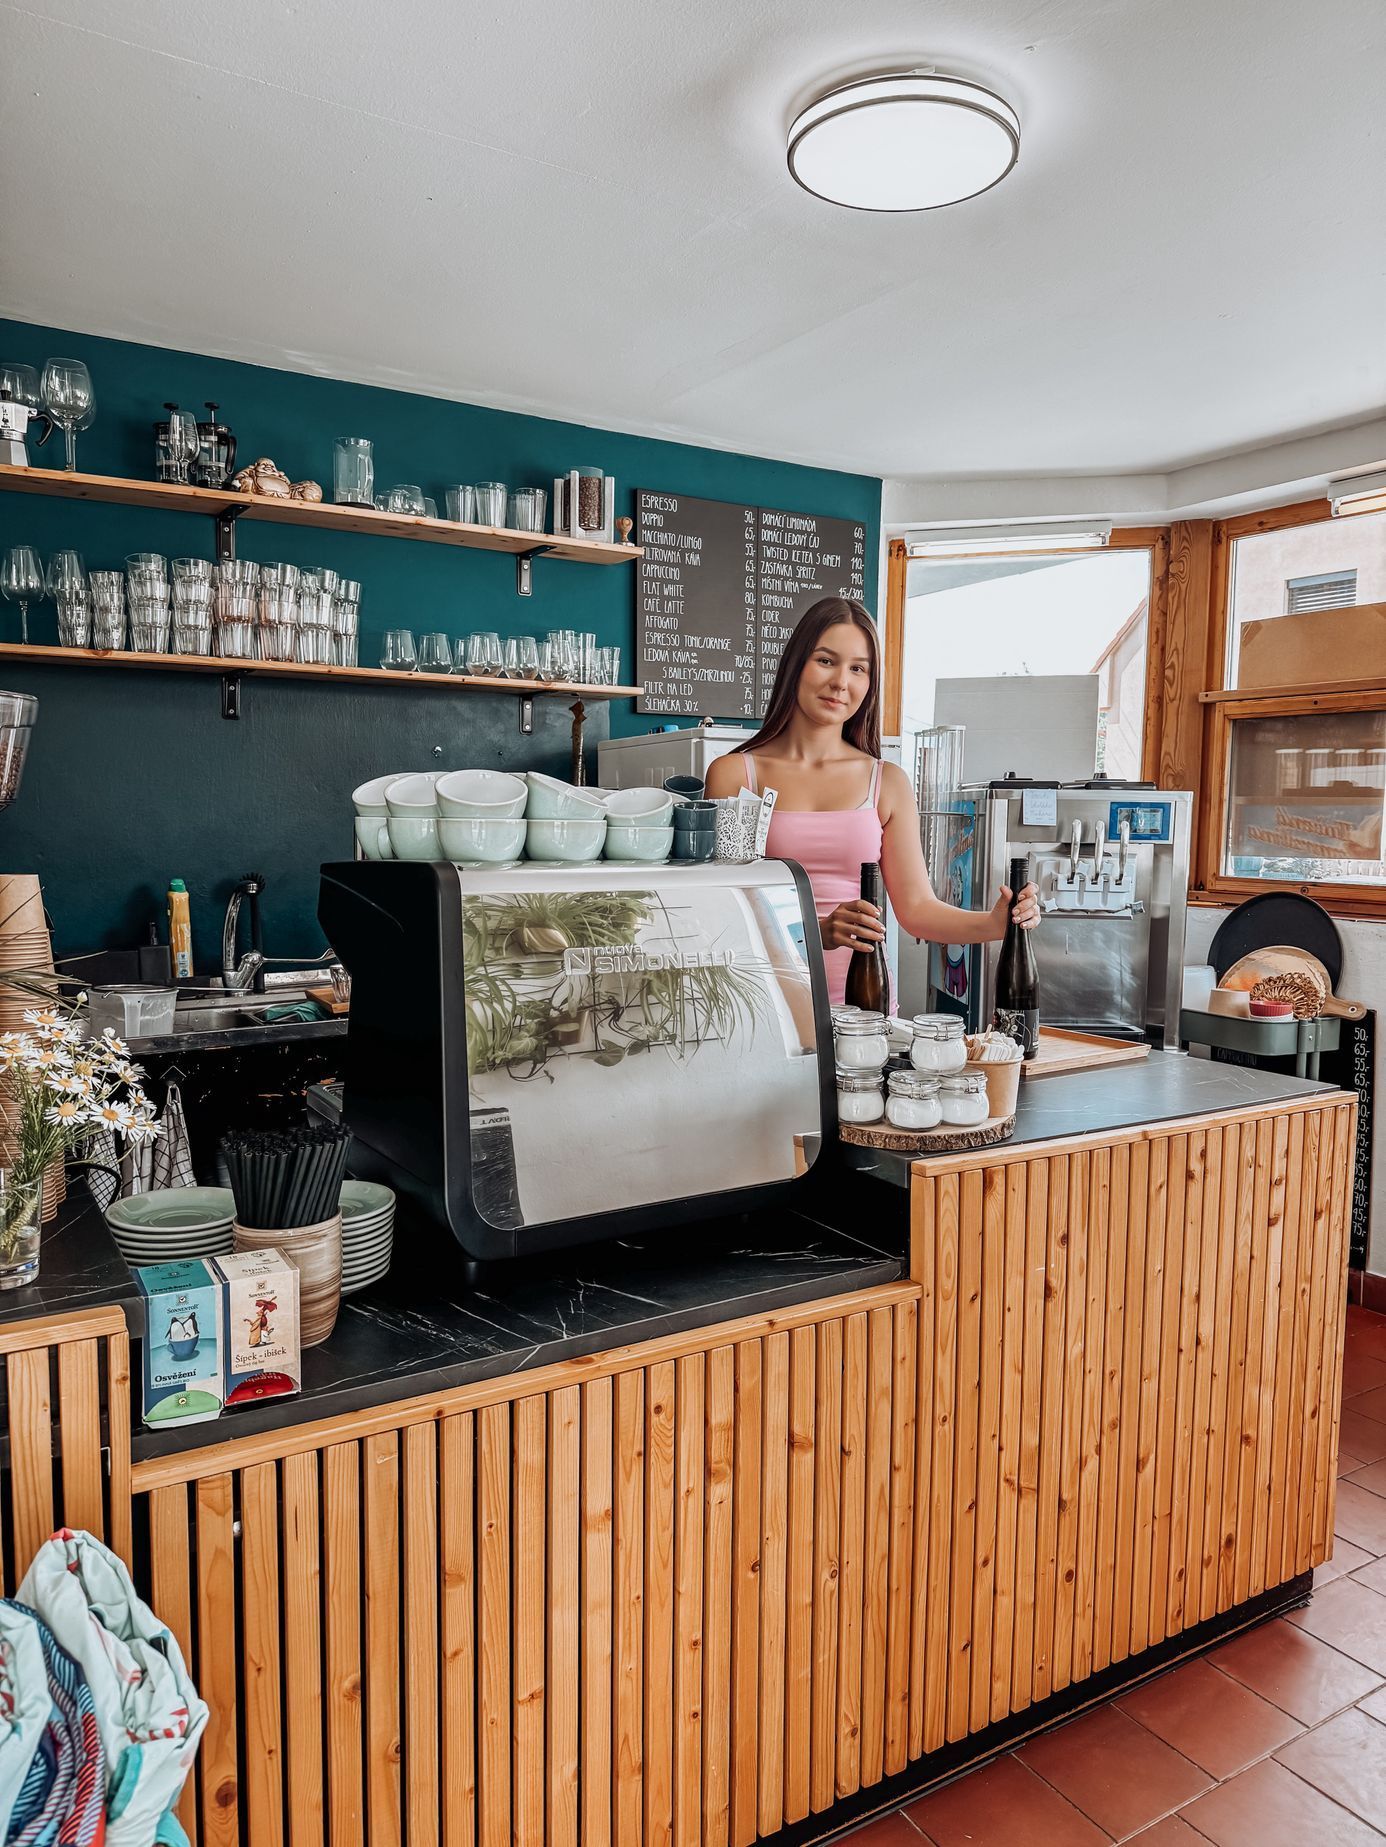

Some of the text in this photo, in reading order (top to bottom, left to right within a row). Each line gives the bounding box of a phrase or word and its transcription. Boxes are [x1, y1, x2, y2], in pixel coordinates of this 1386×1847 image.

[642, 494, 678, 513] ESPRESSO
[642, 512, 664, 527] DOPPIO
[763, 513, 786, 528] DOMÁCÍ
[786, 517, 817, 532] LIMONÁDA
[762, 529, 783, 544] DOMÁCÍ
[785, 532, 807, 547] LEDOVÝ
[809, 534, 820, 548] ČAJ
[685, 552, 701, 566] KÁVA
[763, 546, 788, 561] TWISTED
[823, 554, 841, 568] GINEM
[642, 564, 680, 581] CAPPUCCINO
[761, 561, 793, 578] ZASTÁVKA
[796, 566, 816, 580] SPRITZ
[643, 581, 661, 596] FLAT
[664, 584, 684, 597] WHITE
[762, 576, 783, 591] MÍSTNÍ
[784, 579, 800, 594] VÍNA
[664, 601, 684, 614] LATTE
[762, 594, 794, 609] KOMBUCHA
[645, 616, 679, 630] AFFOGATO
[762, 610, 780, 623] CIDER
[762, 624, 777, 639] NĚCO
[645, 632, 680, 647] ESPRESSO
[644, 648, 670, 663] LEDOVÁ
[673, 649, 691, 664] KÁVA
[762, 641, 785, 656] DOUBLE
[762, 658, 777, 670] PIVO
[644, 681, 664, 695] FILTR
[668, 683, 678, 696] NA
[680, 684, 693, 696] LED
[645, 696, 681, 712] ŠLEHAČKA
[594, 944, 643, 956] nuova
[595, 950, 732, 974] SIMONELLI
[236, 1352, 257, 1364] Šípek
[264, 1347, 287, 1358] ibišek
[155, 1369, 197, 1382] Osvěžení
